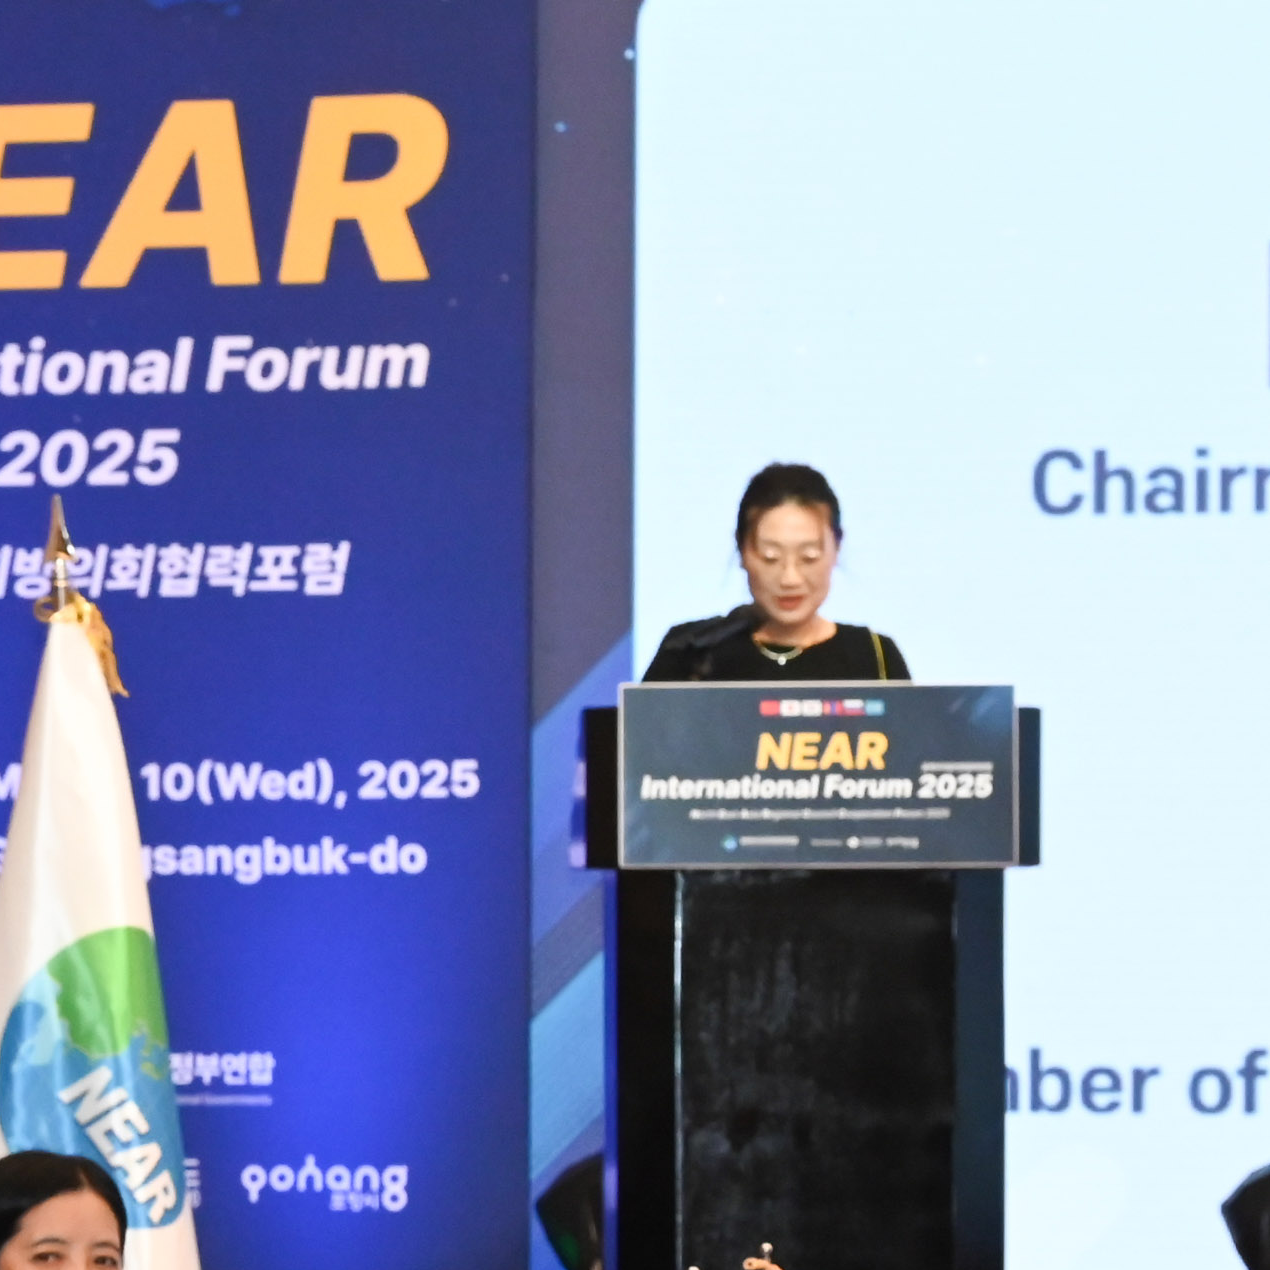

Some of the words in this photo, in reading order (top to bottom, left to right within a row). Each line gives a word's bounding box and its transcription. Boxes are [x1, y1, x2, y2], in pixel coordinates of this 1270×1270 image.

[206, 334, 431, 393] Forum
[1033, 447, 1270, 516] Chair
[756, 732, 889, 771] NEAR
[140, 757, 347, 810] 10(Wed),
[358, 758, 480, 800] 2025
[640, 774, 819, 800] International
[824, 773, 912, 799] Forum
[917, 773, 993, 799] 2025
[1004, 1047, 1161, 1114] ber
[1188, 1047, 1269, 1114] of
[58, 1066, 177, 1224] NEAR
